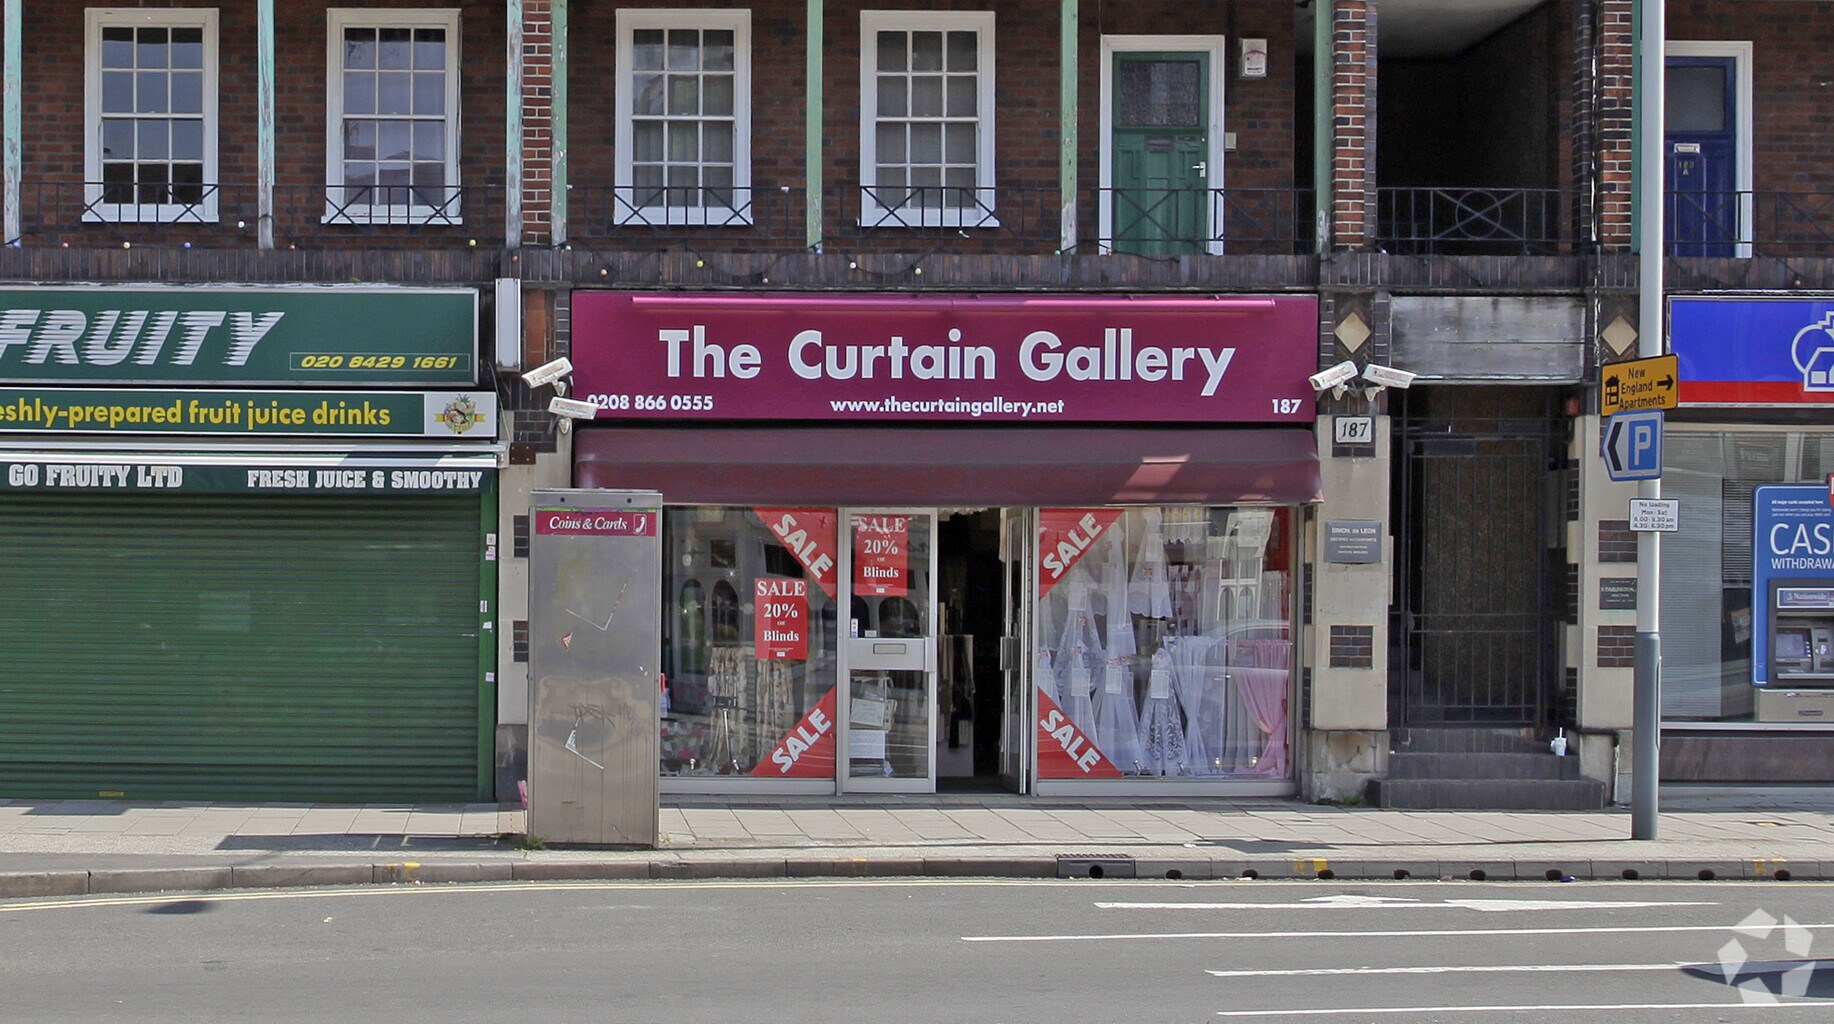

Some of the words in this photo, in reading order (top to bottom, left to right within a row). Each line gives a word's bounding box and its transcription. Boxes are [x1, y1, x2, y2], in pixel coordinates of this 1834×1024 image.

[0, 309, 285, 366] FRUITY
[301, 355, 343, 368] 020
[348, 355, 406, 369] 8429
[413, 356, 457, 369] 1661
[659, 324, 762, 379] The
[788, 328, 996, 380] Curtain
[1018, 327, 1237, 397] Gallery
[1628, 367, 1646, 379] New
[1621, 380, 1653, 395] England
[634, 394, 667, 411] 866
[670, 394, 714, 411] 0555
[830, 396, 1064, 417] www.thecurtaingallery.net
[1272, 398, 1302, 414] 187
[1618, 395, 1666, 411] Apartments
[189, 400, 241, 424] fruit
[247, 400, 306, 431] juice
[312, 401, 391, 426] drinks
[1340, 421, 1368, 437] 187
[1634, 425, 1652, 466] P
[9, 464, 39, 487] GO
[46, 464, 131, 488] FRUITY
[136, 465, 183, 488] LTD
[247, 469, 310, 489] FRESH
[315, 470, 367, 489] JUICE
[372, 470, 385, 489] &
[391, 470, 483, 489] SMOOTHY
[550, 515, 581, 530] Coins
[582, 517, 593, 530] &
[594, 516, 627, 531] Cards
[858, 517, 906, 533] SALE
[773, 513, 833, 579] SALE
[863, 539, 898, 555] 20%
[1043, 513, 1102, 579] SALE
[1769, 523, 1834, 555] CAS
[863, 566, 899, 579] Blinds
[757, 580, 805, 596] SALE
[763, 603, 798, 618] 20%
[763, 630, 799, 642] Blinds
[771, 708, 832, 773] SALE
[1040, 709, 1101, 773] SALE
